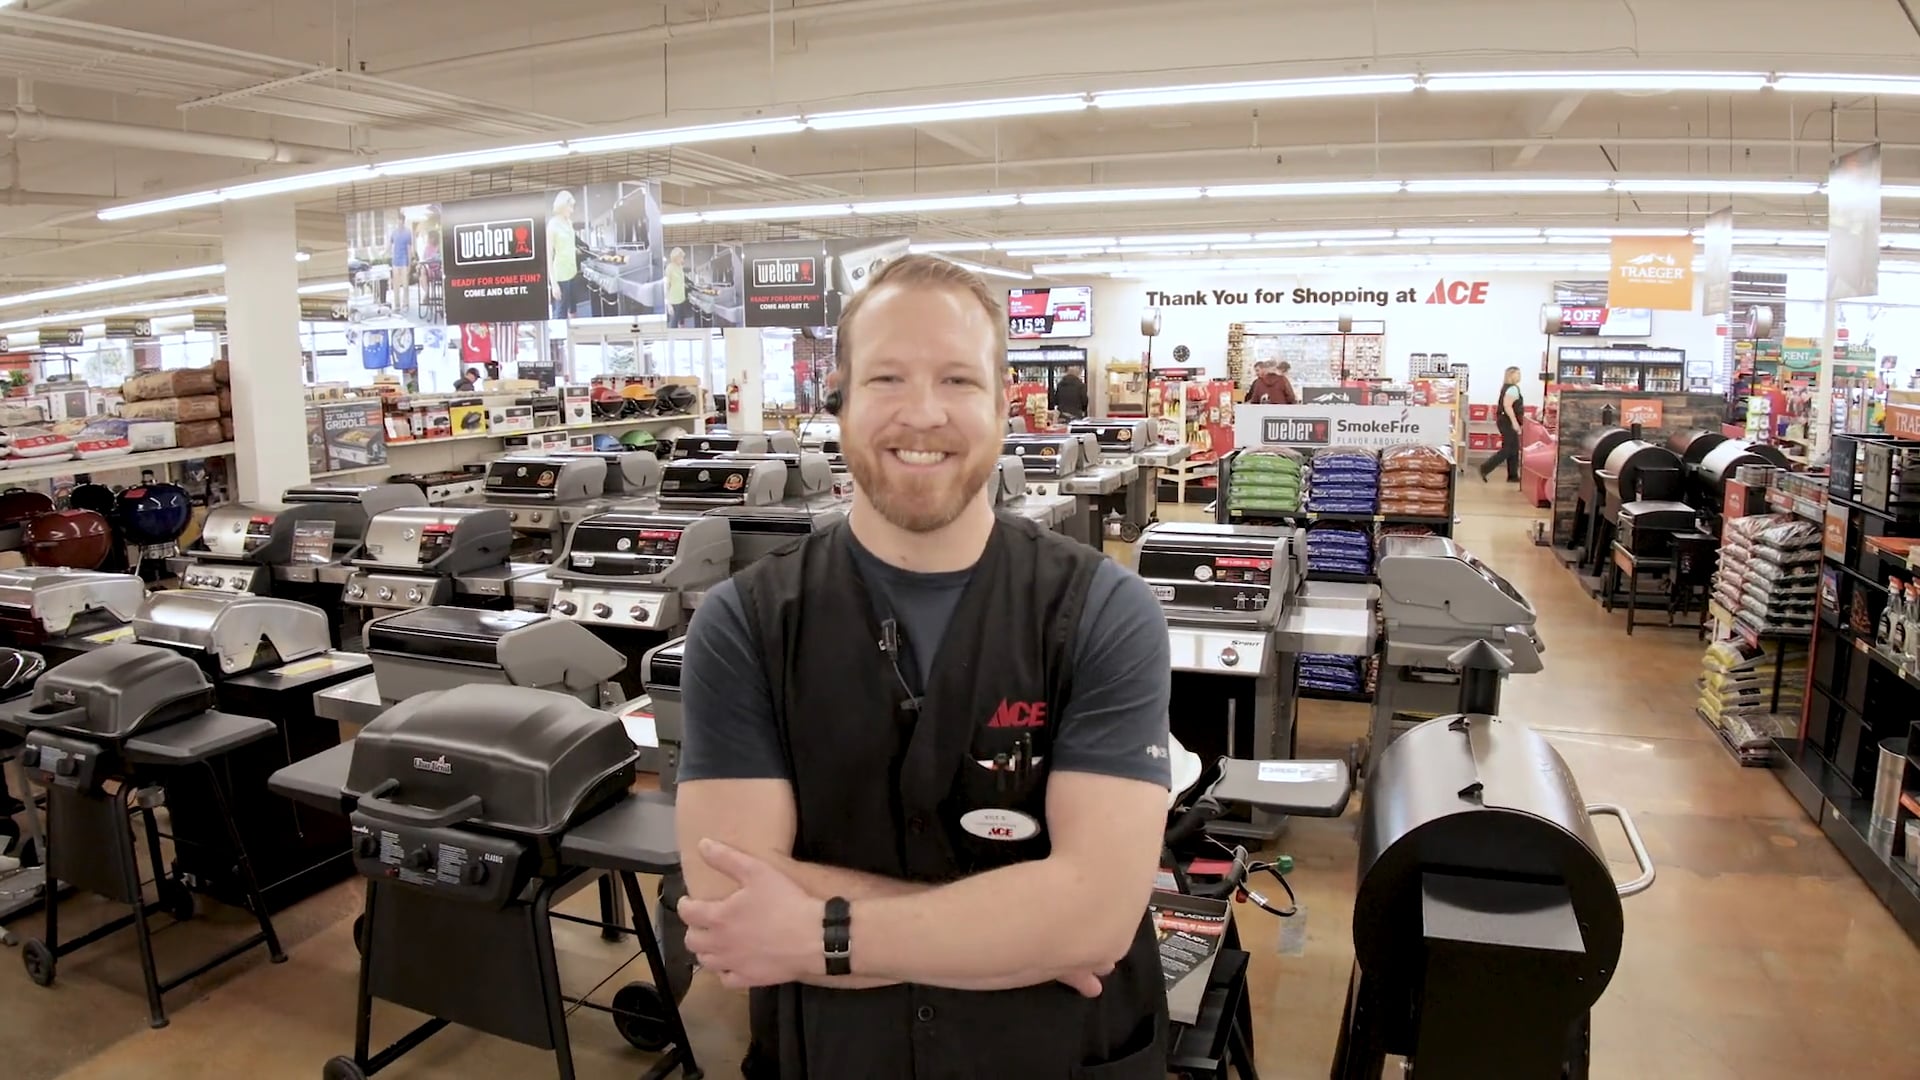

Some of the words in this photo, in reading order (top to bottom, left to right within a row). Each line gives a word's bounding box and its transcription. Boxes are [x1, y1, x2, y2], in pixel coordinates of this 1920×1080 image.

[459, 223, 513, 259] weber
[757, 260, 799, 284] weber
[1619, 266, 1686, 280] TRAEGER
[451, 278, 476, 288] READY
[477, 277, 494, 287] FOR
[494, 275, 519, 285] SOME
[519, 273, 542, 284] FUN?
[463, 288, 486, 298] COME
[486, 287, 502, 297] AND
[503, 286, 519, 296] GET
[519, 286, 529, 295] IT.
[1146, 290, 1207, 307] Thank
[1212, 289, 1249, 305] You
[1254, 288, 1285, 304] for
[1292, 287, 1389, 307] Shopping
[1395, 287, 1417, 304] at
[1425, 278, 1490, 305] ACE
[331, 304, 348, 319] 34
[759, 303, 777, 311] COME
[790, 302, 803, 310] GET
[1572, 309, 1601, 322] OFF
[134, 321, 152, 337] 36
[67, 330, 84, 346] 37
[1783, 351, 1810, 361] RENT
[1847, 344, 1871, 353] RENT
[325, 417, 367, 432] GRIDDLE
[1267, 419, 1313, 442] weber
[1336, 419, 1421, 434] SmokeFire
[1336, 437, 1369, 445] FLAVOR
[986, 697, 1047, 728] ACE
[987, 827, 1013, 838] ACE
[484, 853, 504, 865] CLASSIC
